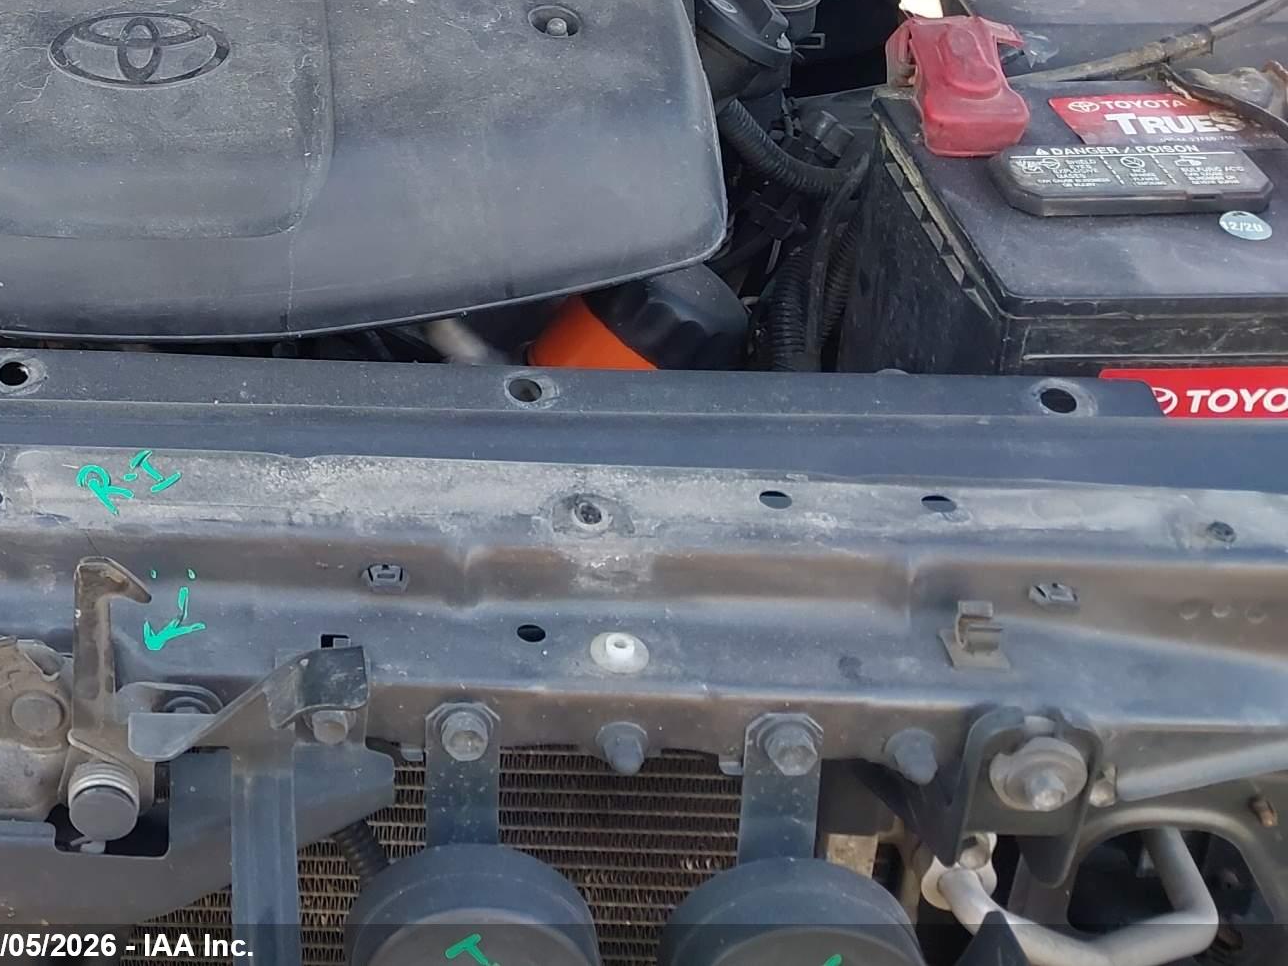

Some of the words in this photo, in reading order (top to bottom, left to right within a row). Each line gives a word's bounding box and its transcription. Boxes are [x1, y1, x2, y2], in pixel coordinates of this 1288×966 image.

[1100, 99, 1187, 110] TOYOTA
[1050, 146, 1120, 155] DANGER
[1135, 145, 1200, 154] POISON
